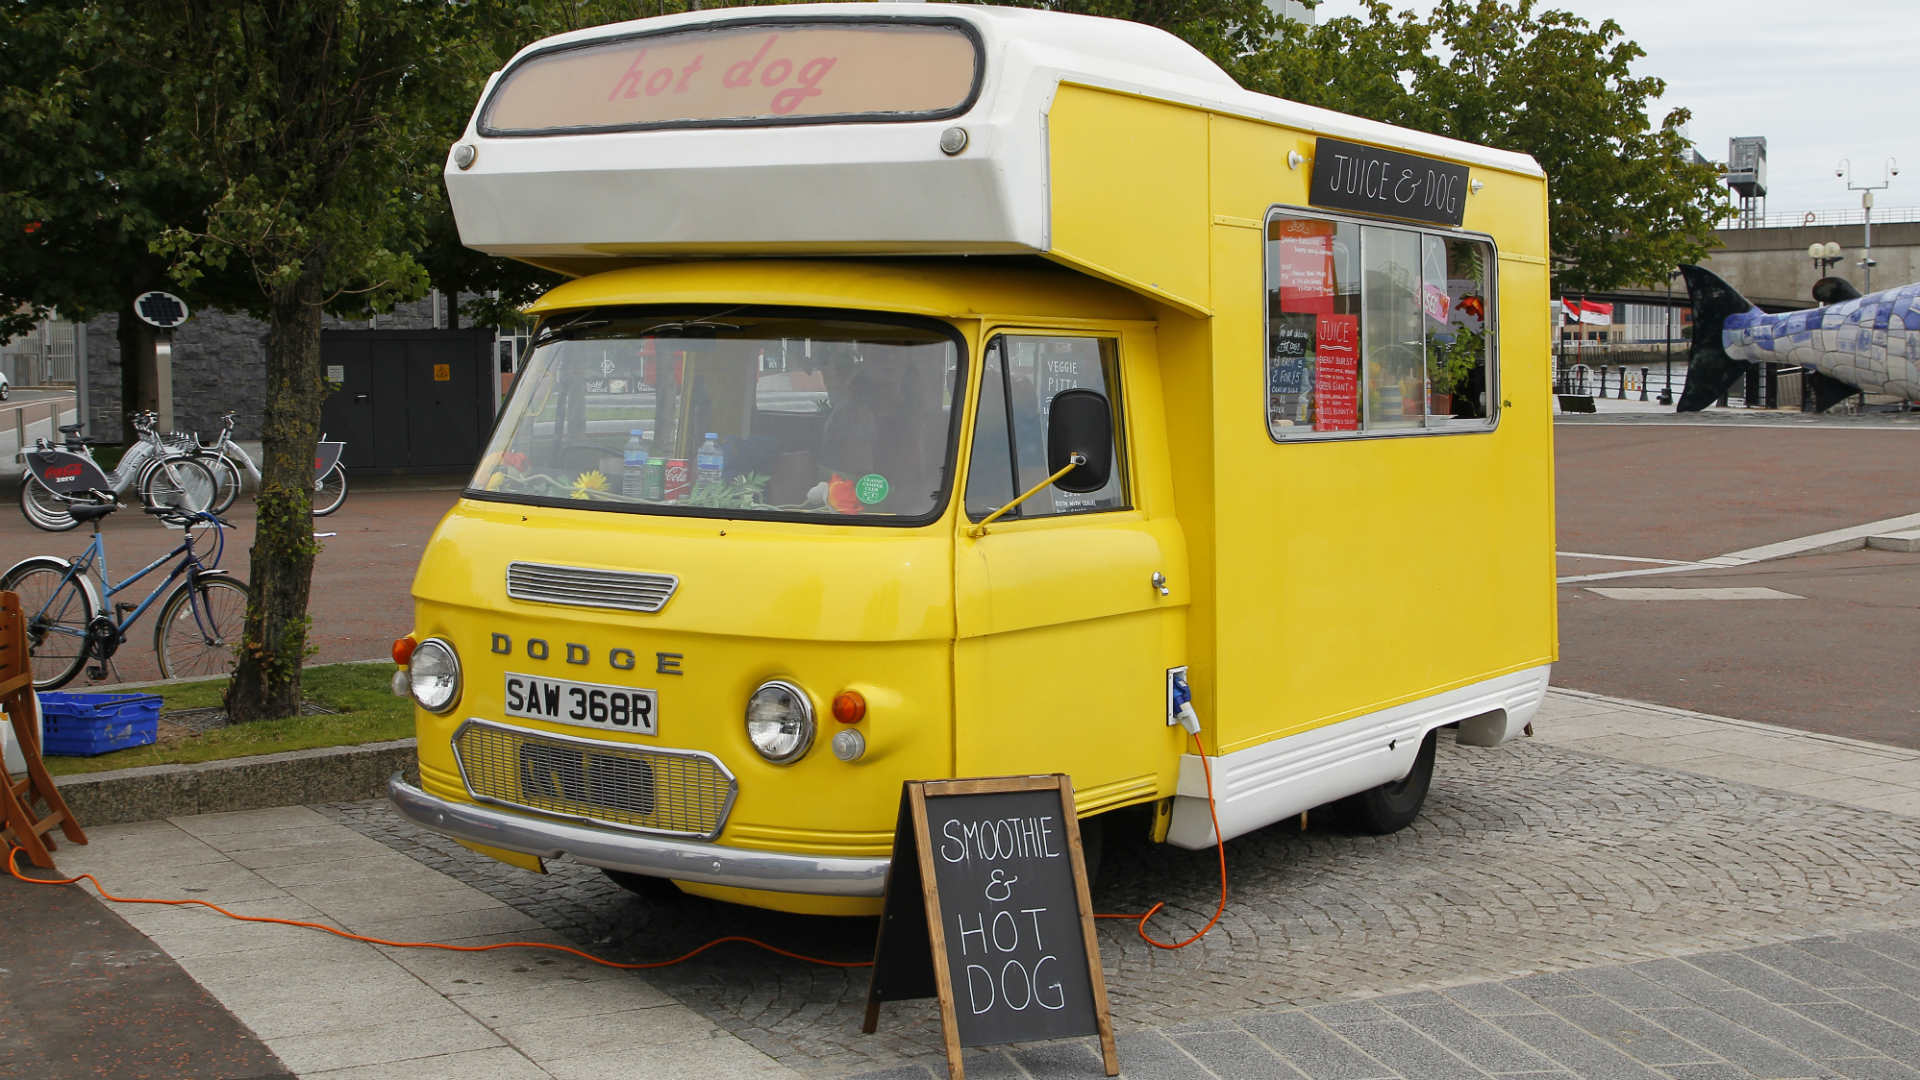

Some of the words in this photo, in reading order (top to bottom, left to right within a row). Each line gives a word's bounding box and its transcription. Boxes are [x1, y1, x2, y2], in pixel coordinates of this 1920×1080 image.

[608, 48, 704, 102] hot
[722, 34, 838, 115] dog
[1330, 154, 1391, 201] JUICE
[1394, 168, 1422, 204] &
[1424, 169, 1458, 213] DOG
[1319, 320, 1352, 343] JUICE
[1047, 360, 1078, 375] VEGGIE
[1048, 375, 1078, 392] PITTA
[491, 632, 684, 675] DODGE
[507, 678, 560, 717] SAW
[568, 687, 652, 729] 368R
[941, 816, 1060, 863] SMOOTHIE
[985, 869, 1018, 902] &
[958, 907, 1047, 956] HOT
[967, 955, 1065, 1015] DOG
